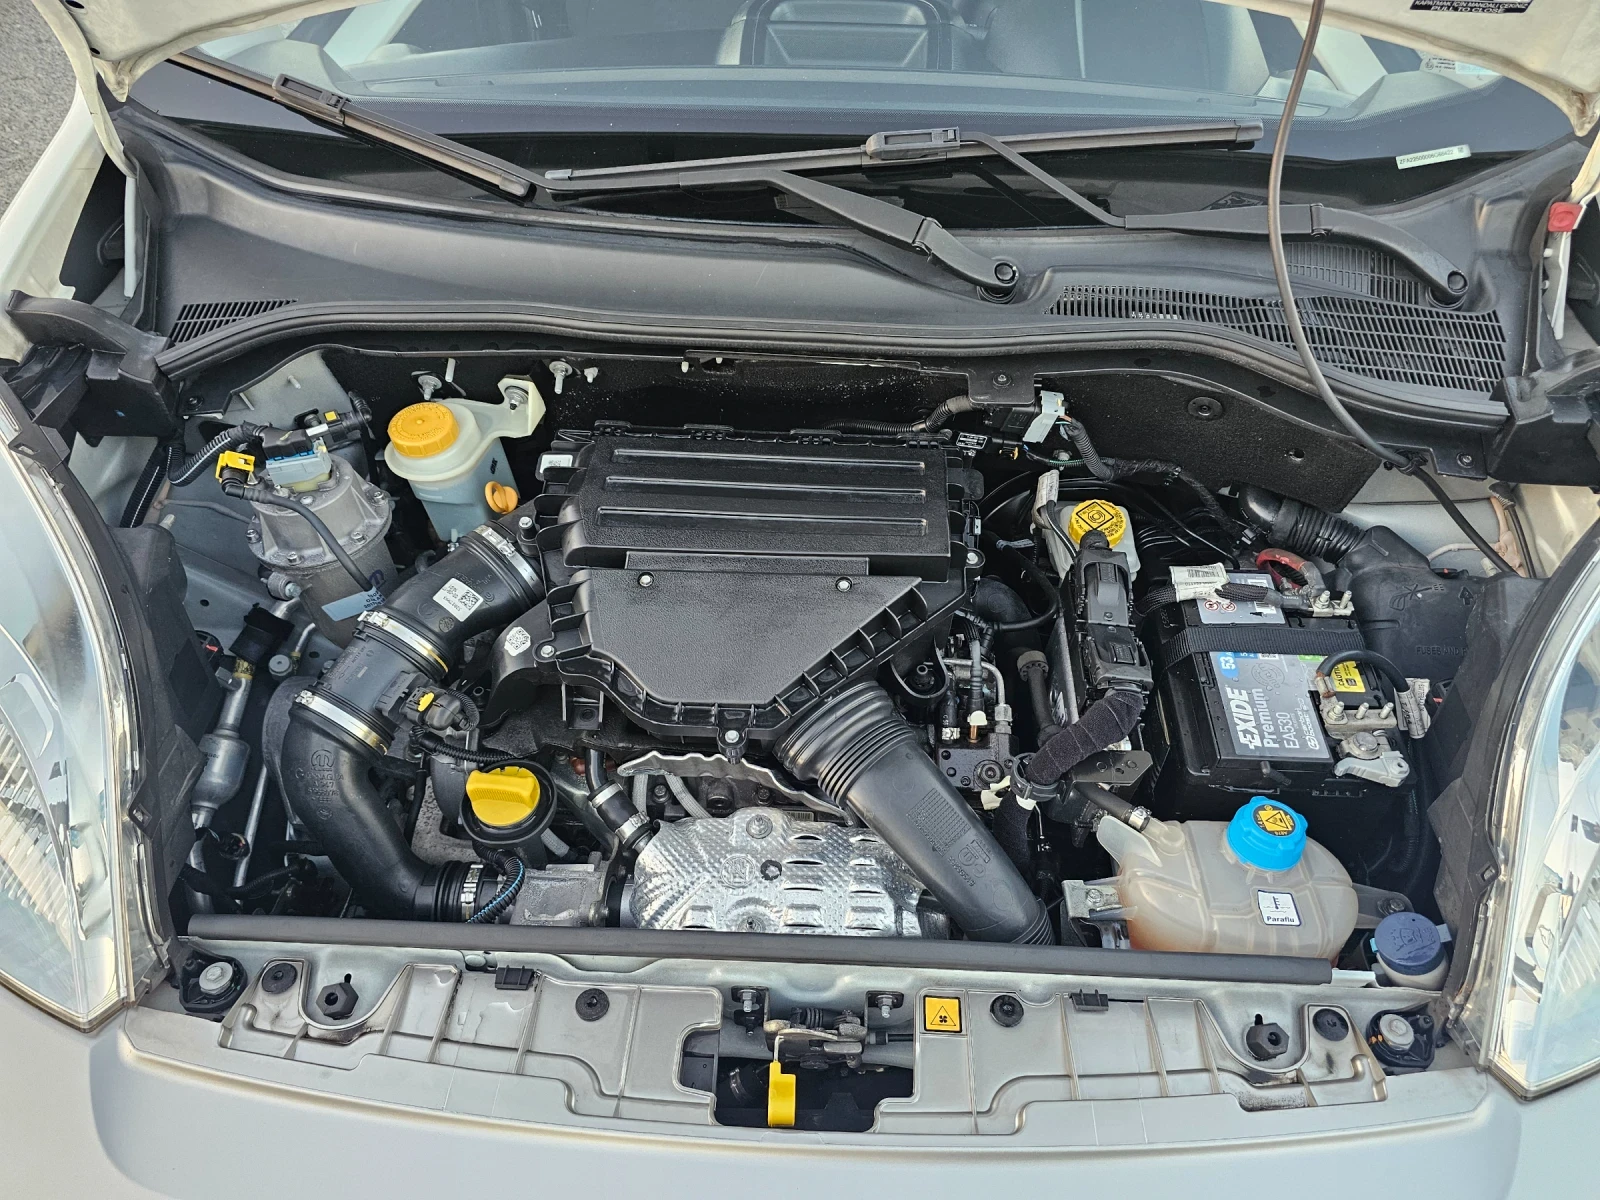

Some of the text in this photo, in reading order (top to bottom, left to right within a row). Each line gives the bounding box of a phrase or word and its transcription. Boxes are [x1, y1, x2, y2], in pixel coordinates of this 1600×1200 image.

[1220, 656, 1236, 670] 53
[1416, 646, 1441, 656] FUSES
[1443, 646, 1460, 656] AND
[1227, 687, 1262, 750] EXIDE
[1251, 688, 1280, 748] Premium
[1276, 712, 1300, 749] EA530
[1266, 915, 1295, 923] Paraflu
